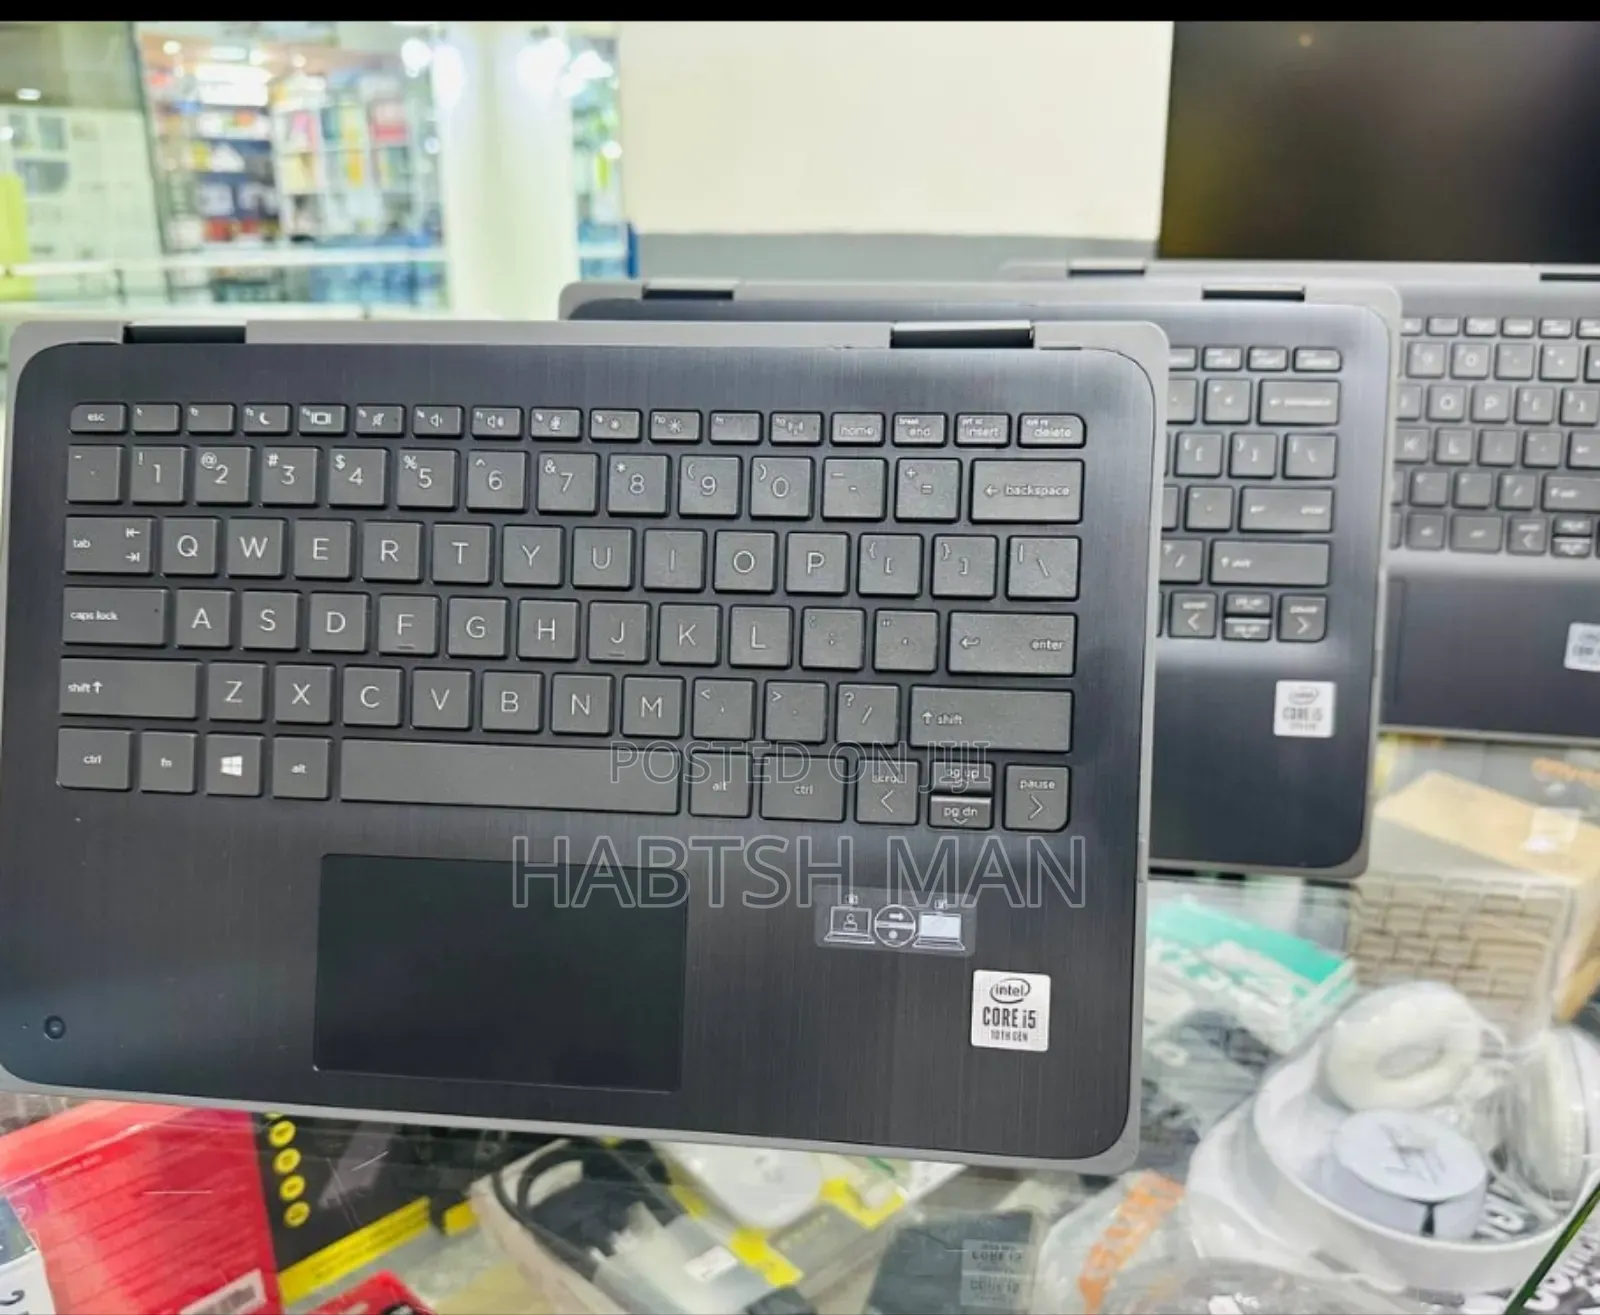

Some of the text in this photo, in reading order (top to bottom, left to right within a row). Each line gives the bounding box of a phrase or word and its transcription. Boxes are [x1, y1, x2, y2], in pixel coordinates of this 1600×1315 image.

[87, 412, 105, 422] esc
[840, 424, 875, 436] home
[909, 427, 931, 437] end
[967, 427, 999, 437] insert
[1033, 427, 1073, 438] delete
[201, 452, 217, 469] @
[267, 454, 279, 467] #
[335, 454, 346, 470] $
[404, 455, 418, 469] %
[545, 459, 556, 474] &
[153, 464, 161, 484] 1
[214, 464, 229, 485] 2
[282, 466, 296, 485] 3
[349, 467, 364, 486] 4
[418, 469, 432, 489] 5
[488, 470, 503, 490] 6
[560, 472, 573, 492] 7
[629, 474, 646, 494] 8
[701, 476, 717, 496] 9
[1005, 484, 1070, 497] backspace
[73, 538, 90, 549] tab
[177, 535, 198, 556] Q
[239, 536, 267, 558] W
[312, 538, 329, 560] E
[380, 540, 399, 562] R
[451, 542, 468, 564] T
[522, 545, 540, 566] Y
[592, 547, 611, 569] U
[669, 549, 675, 571] I
[733, 550, 755, 573] O
[807, 552, 825, 574] P
[70, 609, 118, 621] caps lock
[191, 608, 212, 629] A
[260, 609, 276, 631] S
[326, 612, 346, 633] D
[397, 614, 414, 636] F
[465, 616, 486, 638] G
[537, 619, 556, 641] H
[610, 621, 626, 643] J
[678, 624, 697, 646] K
[751, 626, 767, 648] L
[1031, 638, 1064, 650] enter
[67, 682, 91, 694] shift
[225, 681, 243, 703] Z
[292, 684, 311, 706] X
[360, 686, 380, 708] C
[430, 688, 450, 711] V
[502, 691, 519, 712] B
[571, 694, 591, 716] N
[640, 696, 662, 719] M
[845, 692, 855, 707] ?
[862, 706, 873, 724] /
[937, 712, 963, 725] shift
[83, 754, 101, 764] ctrl
[161, 757, 172, 767] fn
[292, 764, 306, 774] alt
[712, 779, 727, 791] alt
[793, 782, 813, 795] ctrl
[1019, 778, 1056, 790] pause
[943, 804, 978, 818] pg dn
[994, 983, 1025, 997] intel
[982, 1006, 1037, 1029] CORE i5
